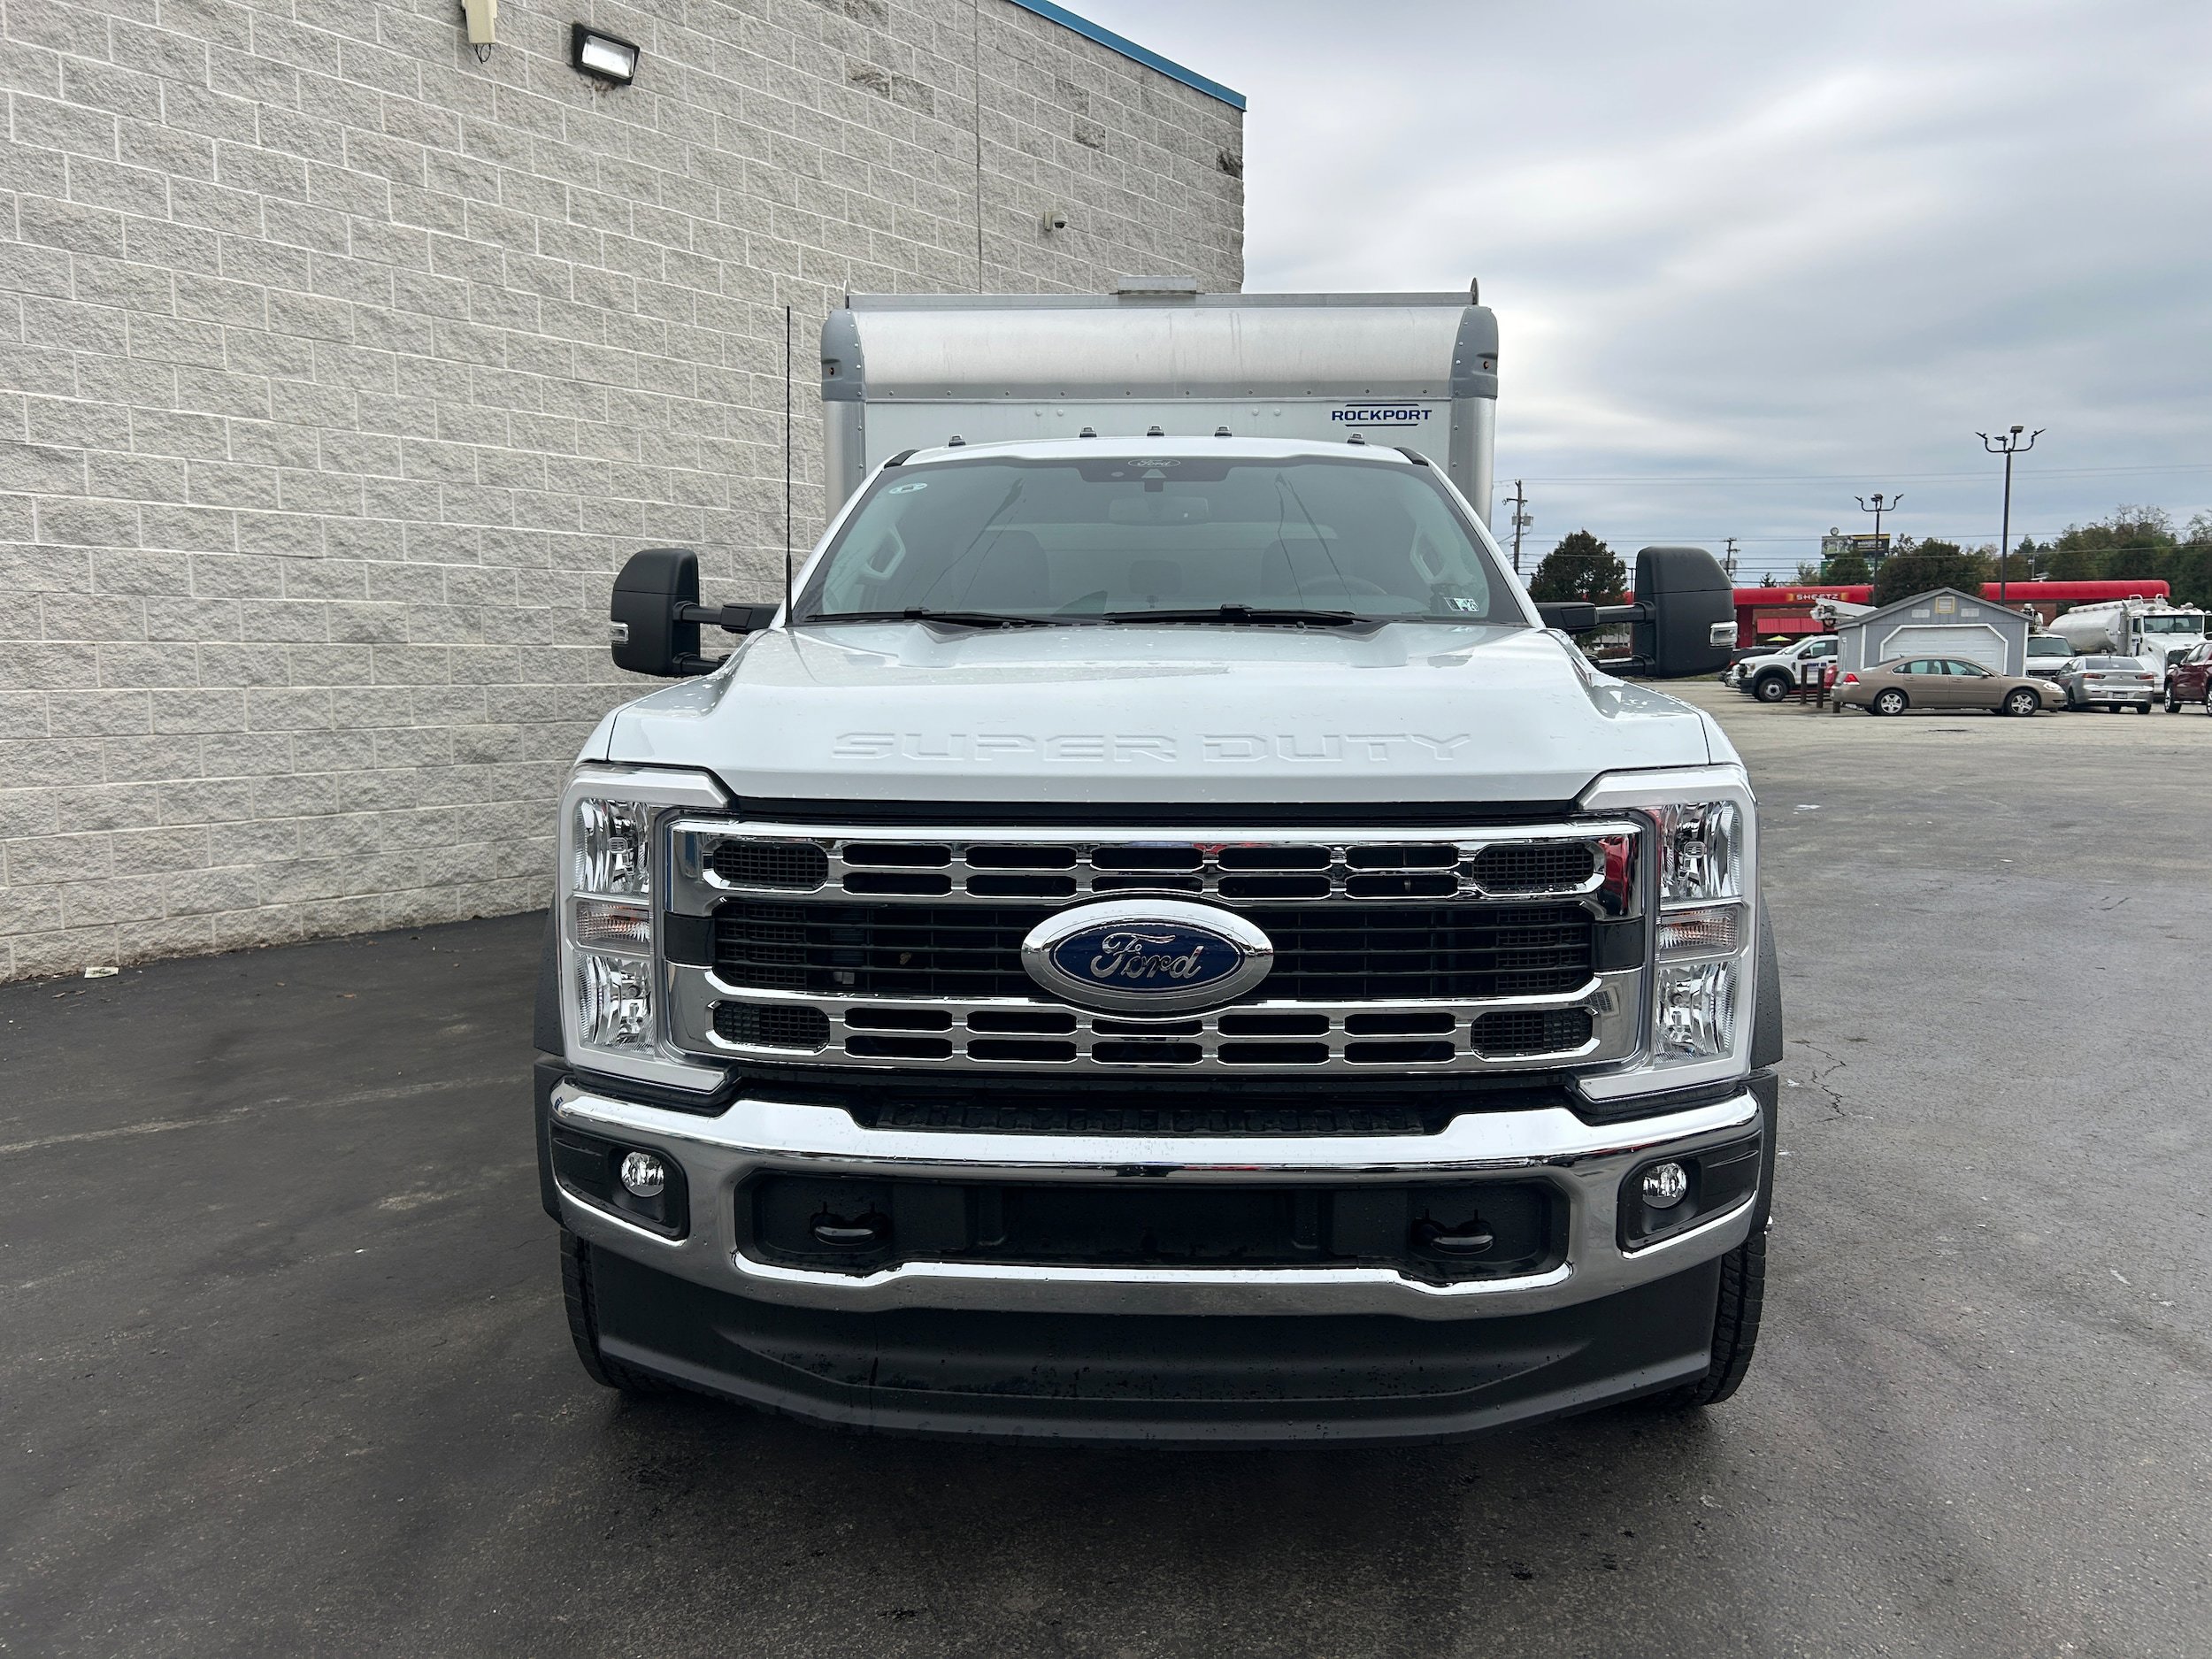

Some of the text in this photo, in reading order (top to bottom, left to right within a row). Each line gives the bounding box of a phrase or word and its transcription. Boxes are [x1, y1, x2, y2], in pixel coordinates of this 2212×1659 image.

[1331, 410, 1432, 421] ROCKPORT
[831, 732, 1472, 763] SUPER DUTY
[1089, 932, 1204, 979] Ford
